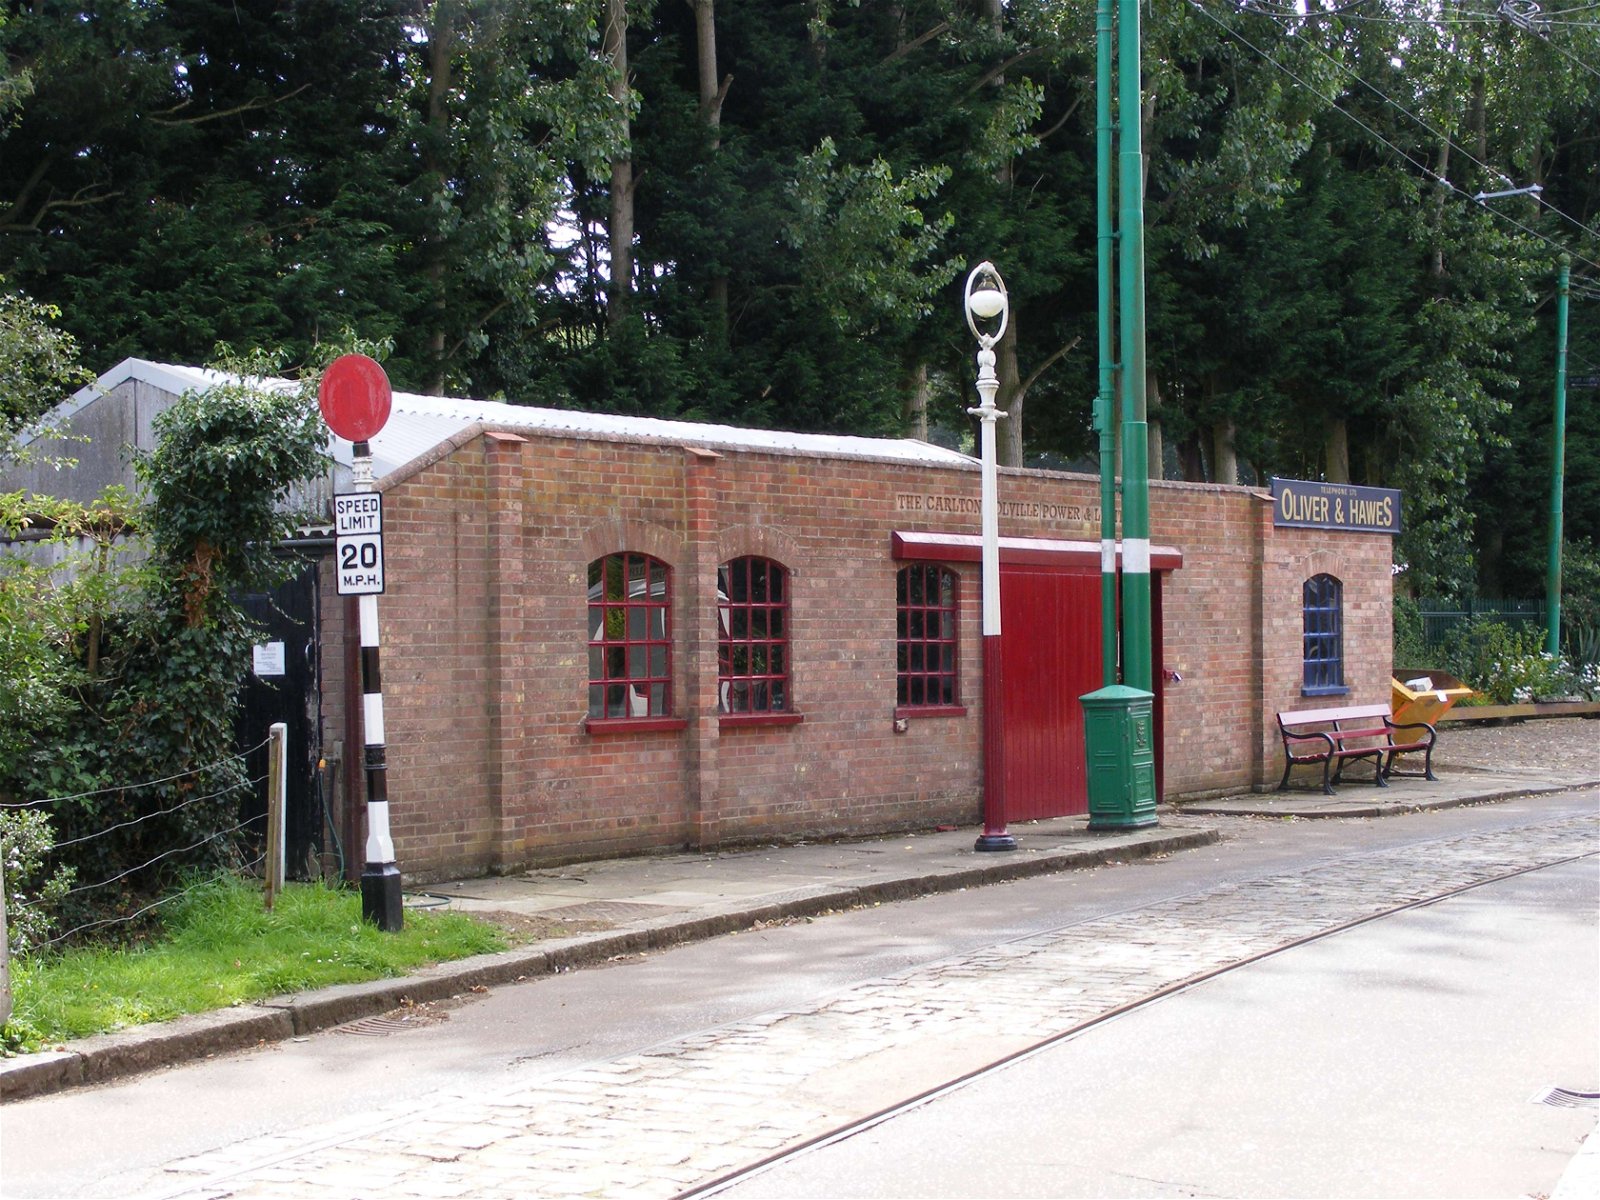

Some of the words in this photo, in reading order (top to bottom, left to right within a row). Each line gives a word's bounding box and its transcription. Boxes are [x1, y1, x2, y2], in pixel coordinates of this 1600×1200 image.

[337, 498, 378, 514] SPEED
[897, 494, 922, 510] THE
[926, 495, 982, 514] CARLTON
[997, 500, 1039, 518] OLVILLE
[1042, 504, 1081, 520] POWER
[1083, 507, 1092, 521] &
[1282, 488, 1329, 522] OLIVER
[1335, 497, 1345, 524] &
[1349, 496, 1392, 527] HAWES
[341, 515, 375, 530] LIMIT
[341, 542, 377, 569] 20
[344, 574, 380, 586] M.P.H.
